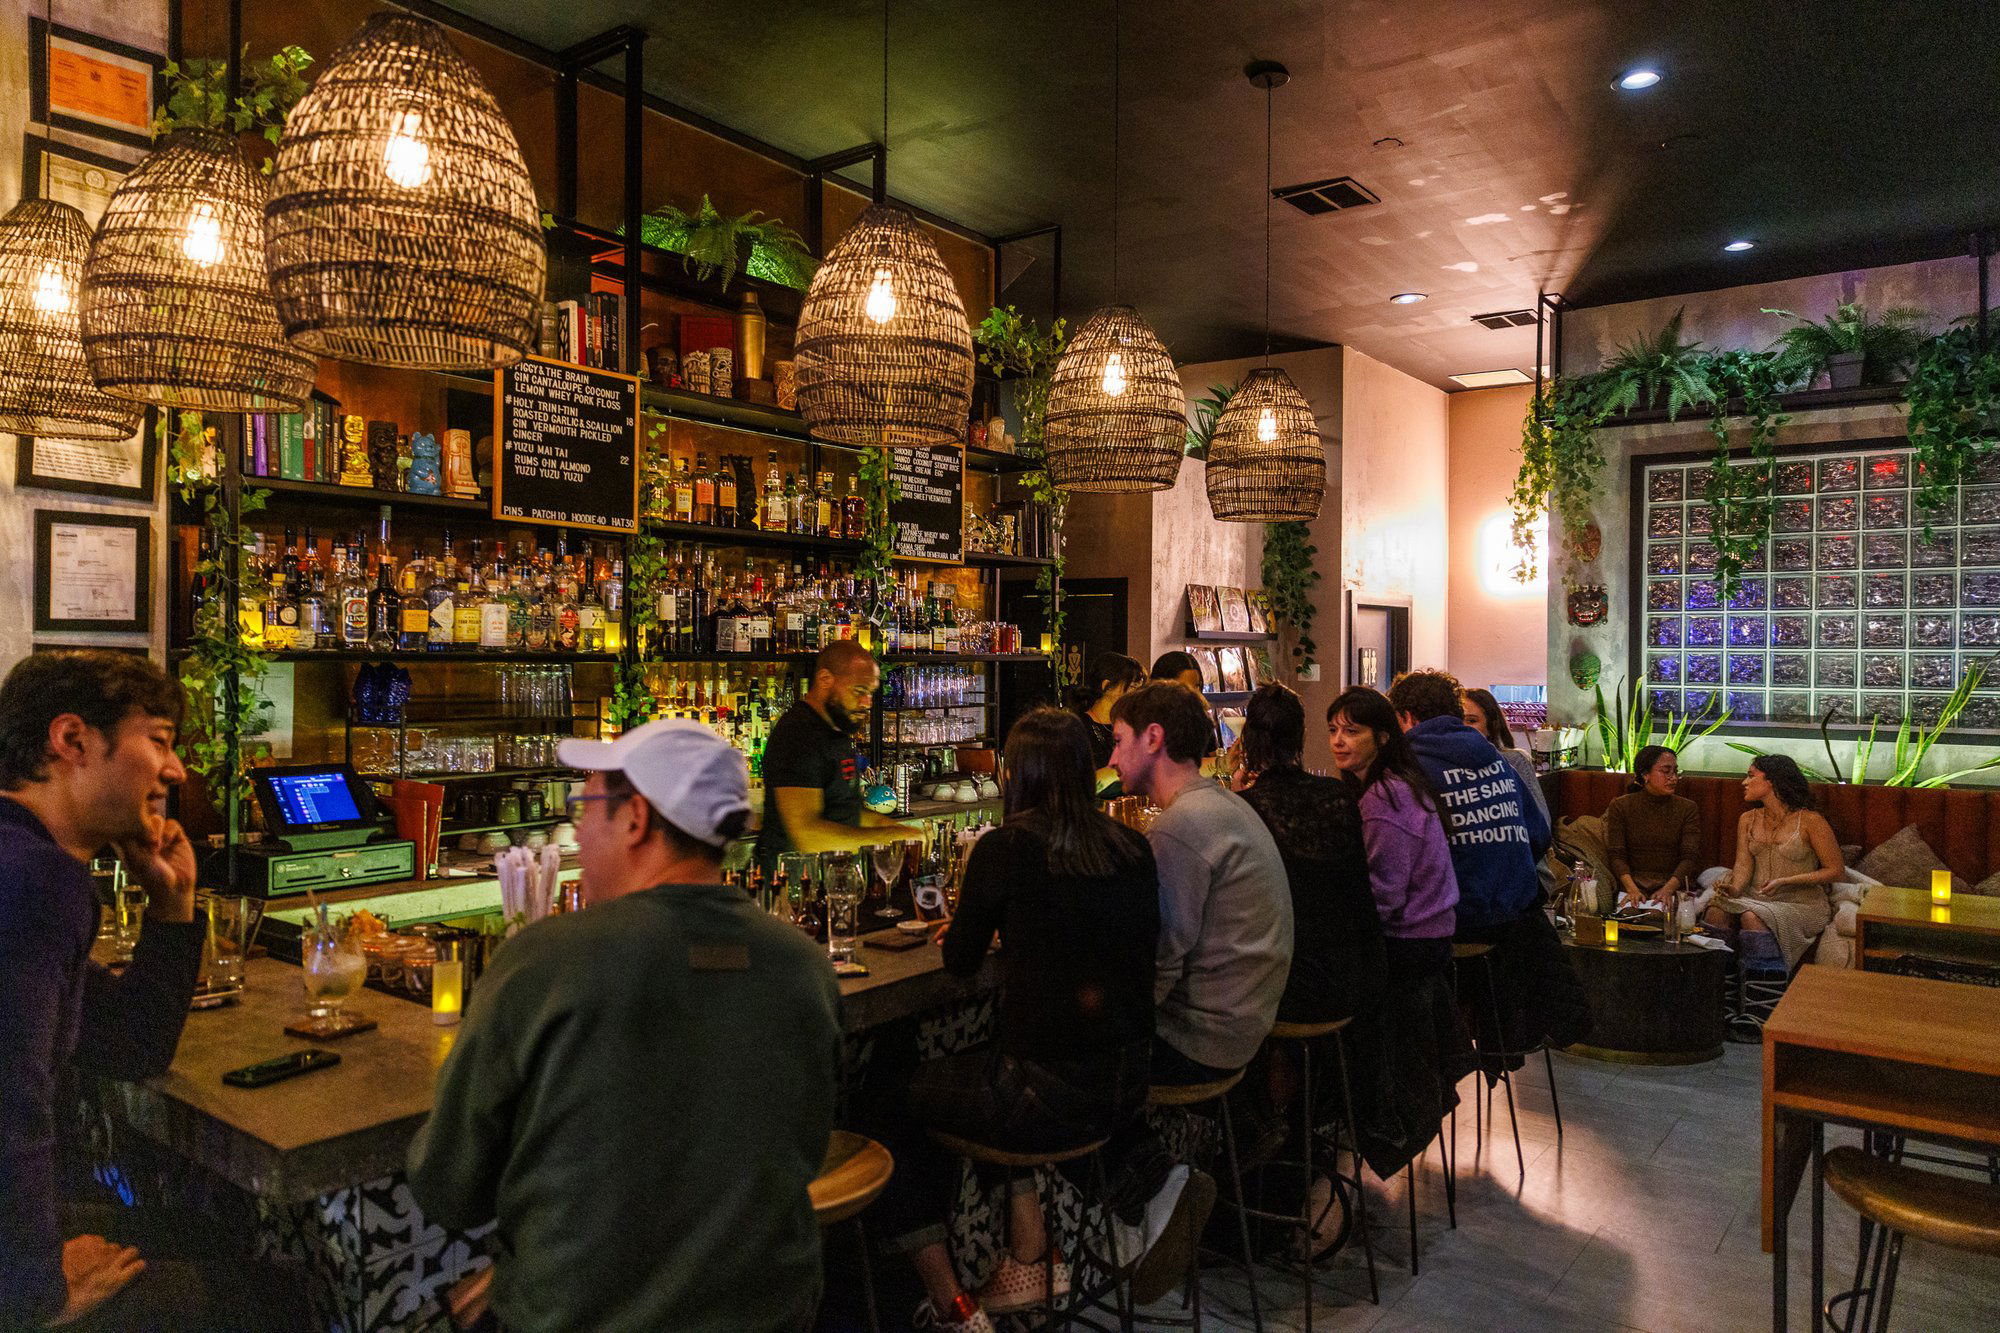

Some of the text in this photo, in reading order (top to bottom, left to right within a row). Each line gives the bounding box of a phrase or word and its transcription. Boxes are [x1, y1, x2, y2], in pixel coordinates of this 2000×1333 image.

[514, 372, 620, 400] GIN CANTALOUPE COCONUT
[565, 371, 590, 384] BRAIN
[515, 382, 621, 411] LEMON WHEY PORK FLOSS
[627, 384, 635, 393] 18
[513, 408, 549, 422] ROASTED
[538, 401, 578, 417] TRINI-TINI
[513, 418, 612, 443] GIN VERMOUTH PICKLED
[626, 417, 634, 427] 18
[513, 429, 543, 442] GINGER
[538, 444, 552, 456] MAI
[555, 447, 568, 458] TAI
[915, 450, 930, 460] PISCO
[515, 454, 539, 467] RUMS
[560, 460, 591, 474] ALMOND
[620, 455, 630, 465] 22
[894, 454, 911, 464] MANGO
[949, 464, 960, 473] RICE
[515, 465, 583, 483] YUZU YUZU YUZU
[902, 482, 923, 493] ROSELLE
[1443, 760, 1505, 785] IT'S NOT
[1440, 779, 1517, 807] THE SAME
[1451, 801, 1519, 827] DANCING
[1451, 825, 1513, 845] ITHOUT
